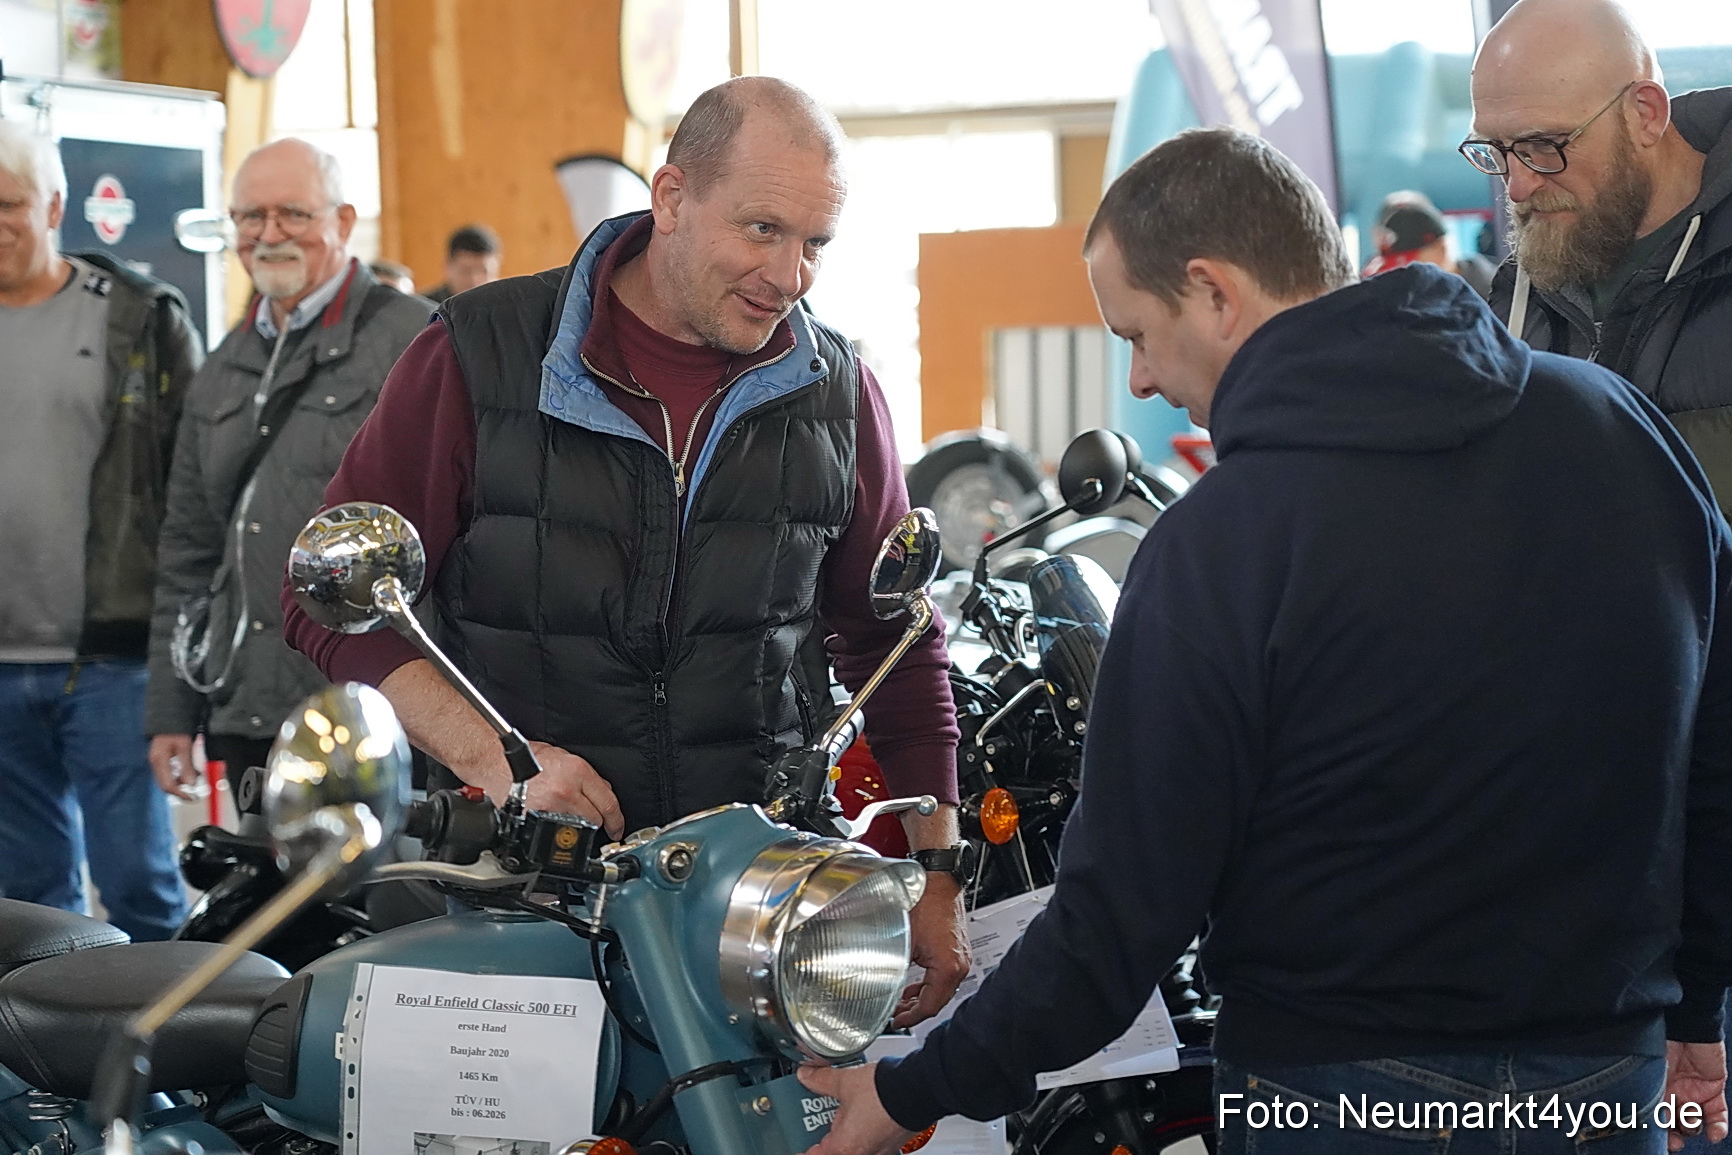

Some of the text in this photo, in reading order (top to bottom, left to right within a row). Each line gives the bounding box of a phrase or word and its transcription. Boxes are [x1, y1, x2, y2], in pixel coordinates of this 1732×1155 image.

[396, 993, 577, 1016] Royal Enfield Classic 500 EFI
[482, 1023, 507, 1033] Hand
[450, 1046, 509, 1058] Baujahr 2020
[459, 1071, 498, 1082] 1465 Km
[455, 1094, 477, 1105] TÜV
[485, 1097, 500, 1107] HU
[450, 1107, 464, 1117] bis
[472, 1109, 506, 1119] 06.2026
